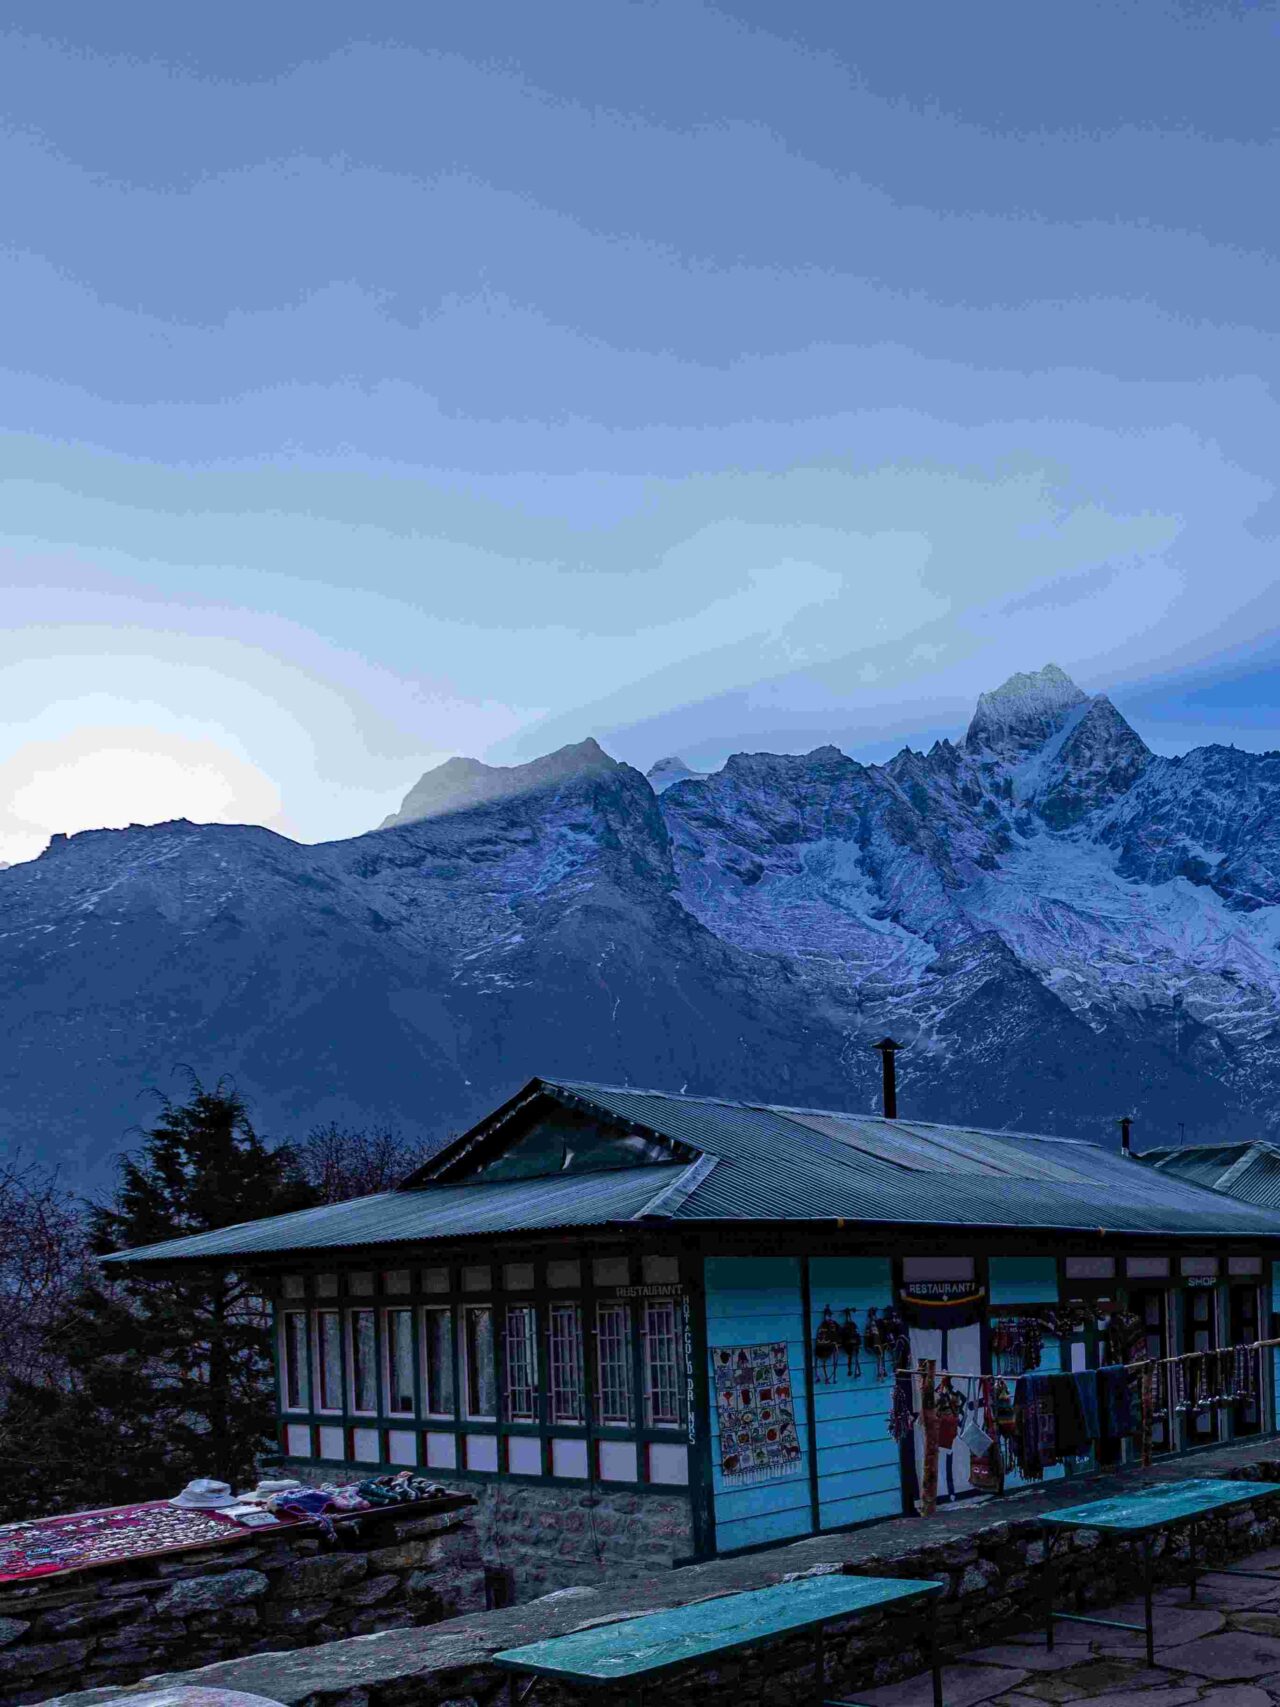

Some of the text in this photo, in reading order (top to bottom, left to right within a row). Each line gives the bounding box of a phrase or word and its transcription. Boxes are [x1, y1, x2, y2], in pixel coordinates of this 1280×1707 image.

[616, 1284, 684, 1297] RESTAURANT
[1187, 1276, 1217, 1287] SHOP
[682, 1295, 690, 1323] HOT
[684, 1333, 693, 1375] COLD
[687, 1378, 696, 1445] DRINKS
